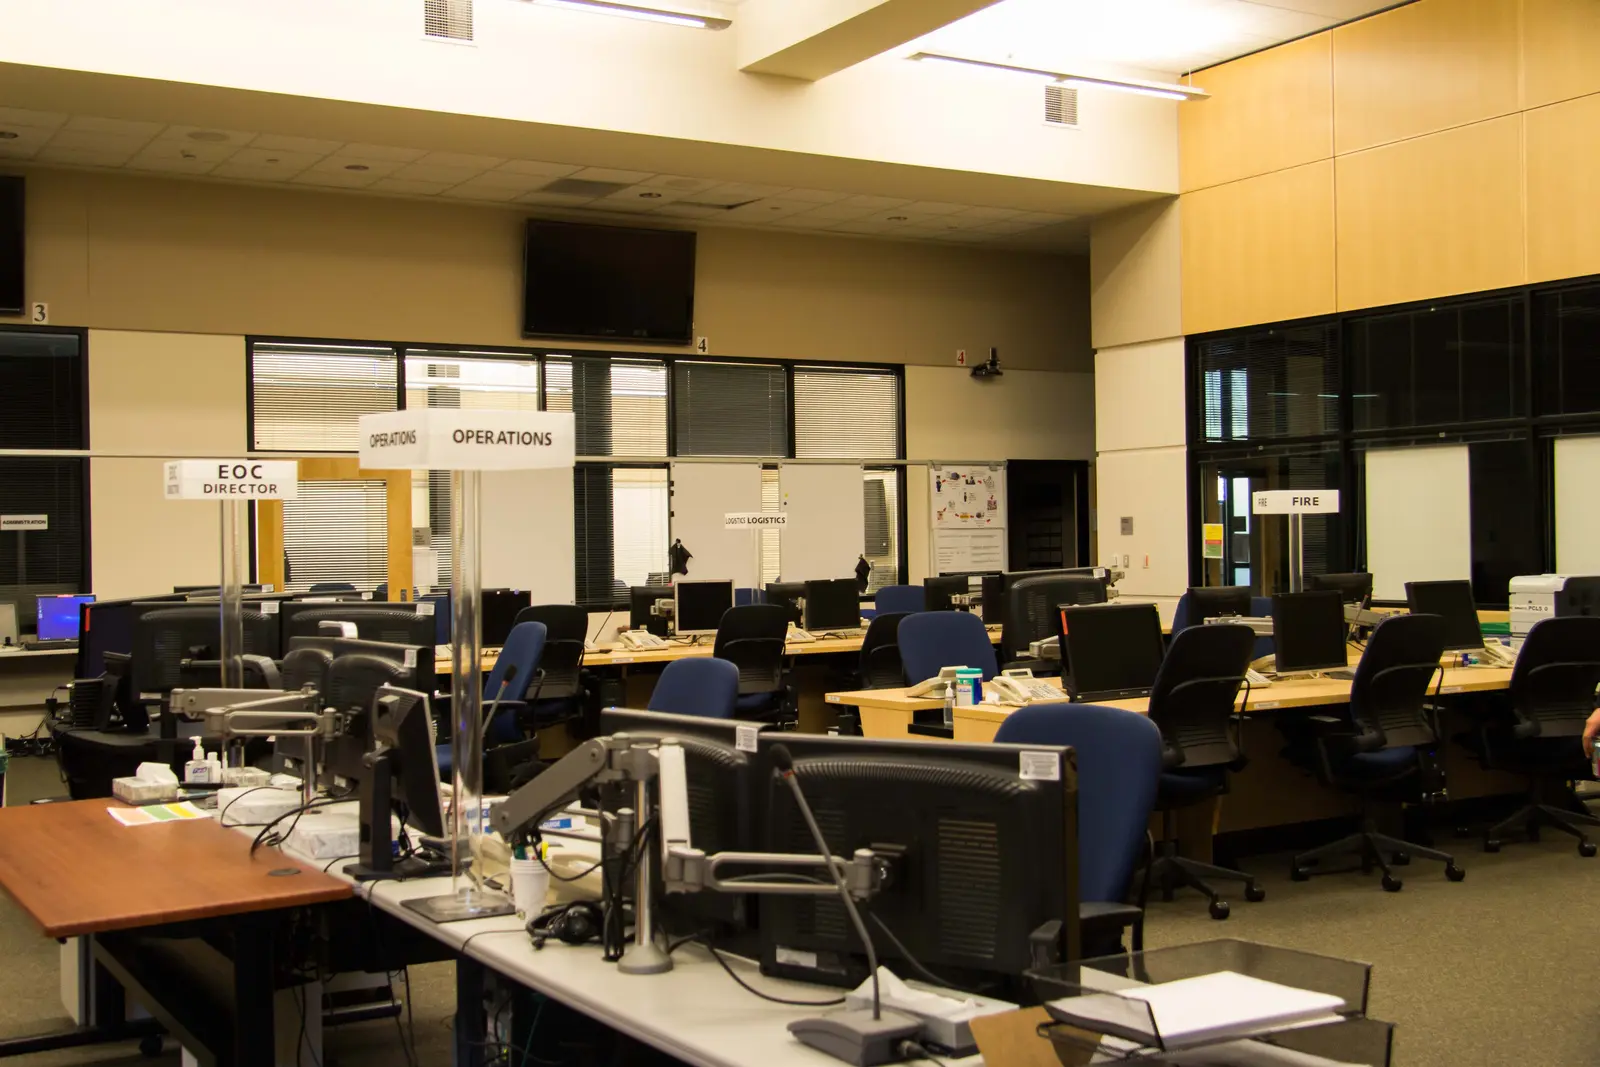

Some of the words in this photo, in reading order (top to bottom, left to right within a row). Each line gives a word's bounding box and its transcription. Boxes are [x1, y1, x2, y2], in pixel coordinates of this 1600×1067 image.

[34, 304, 46, 322] 3
[698, 338, 706, 353] 4
[957, 351, 965, 365] 4
[369, 429, 417, 448] OPERATIONS
[453, 428, 553, 446] OPERATIONS
[218, 464, 263, 480] EOC
[203, 483, 278, 494] DIRECTOR
[1292, 496, 1320, 507] FIRE
[725, 516, 746, 525] LOGISTICS
[747, 516, 786, 524] LOGISTICS
